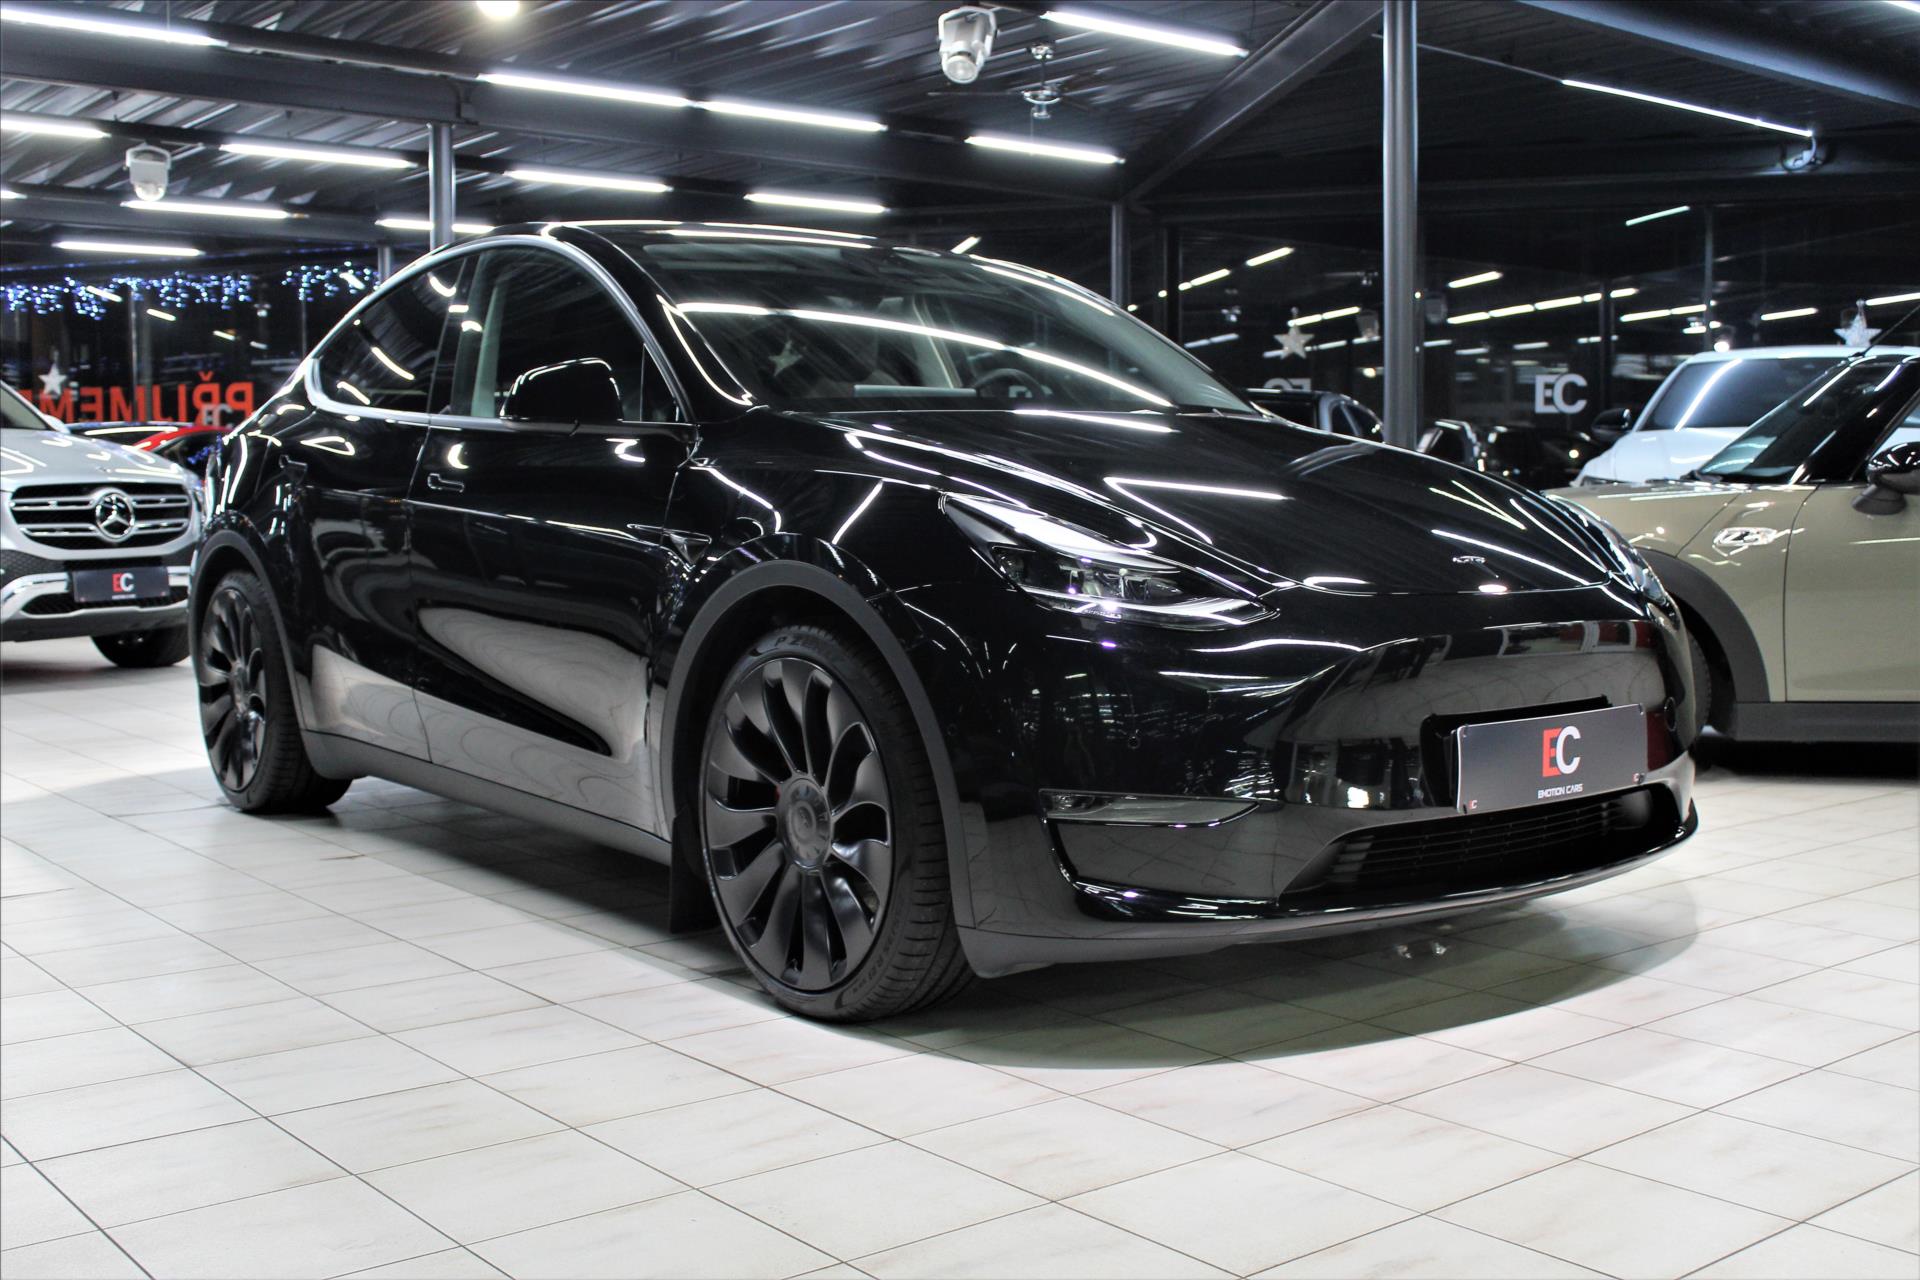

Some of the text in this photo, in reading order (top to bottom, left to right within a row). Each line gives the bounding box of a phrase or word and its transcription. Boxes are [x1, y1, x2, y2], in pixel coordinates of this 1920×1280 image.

[1534, 373, 1588, 414] EC
[112, 572, 135, 592] EC
[1542, 725, 1582, 777] EC
[1538, 783, 1584, 799] EMOTION CARS
